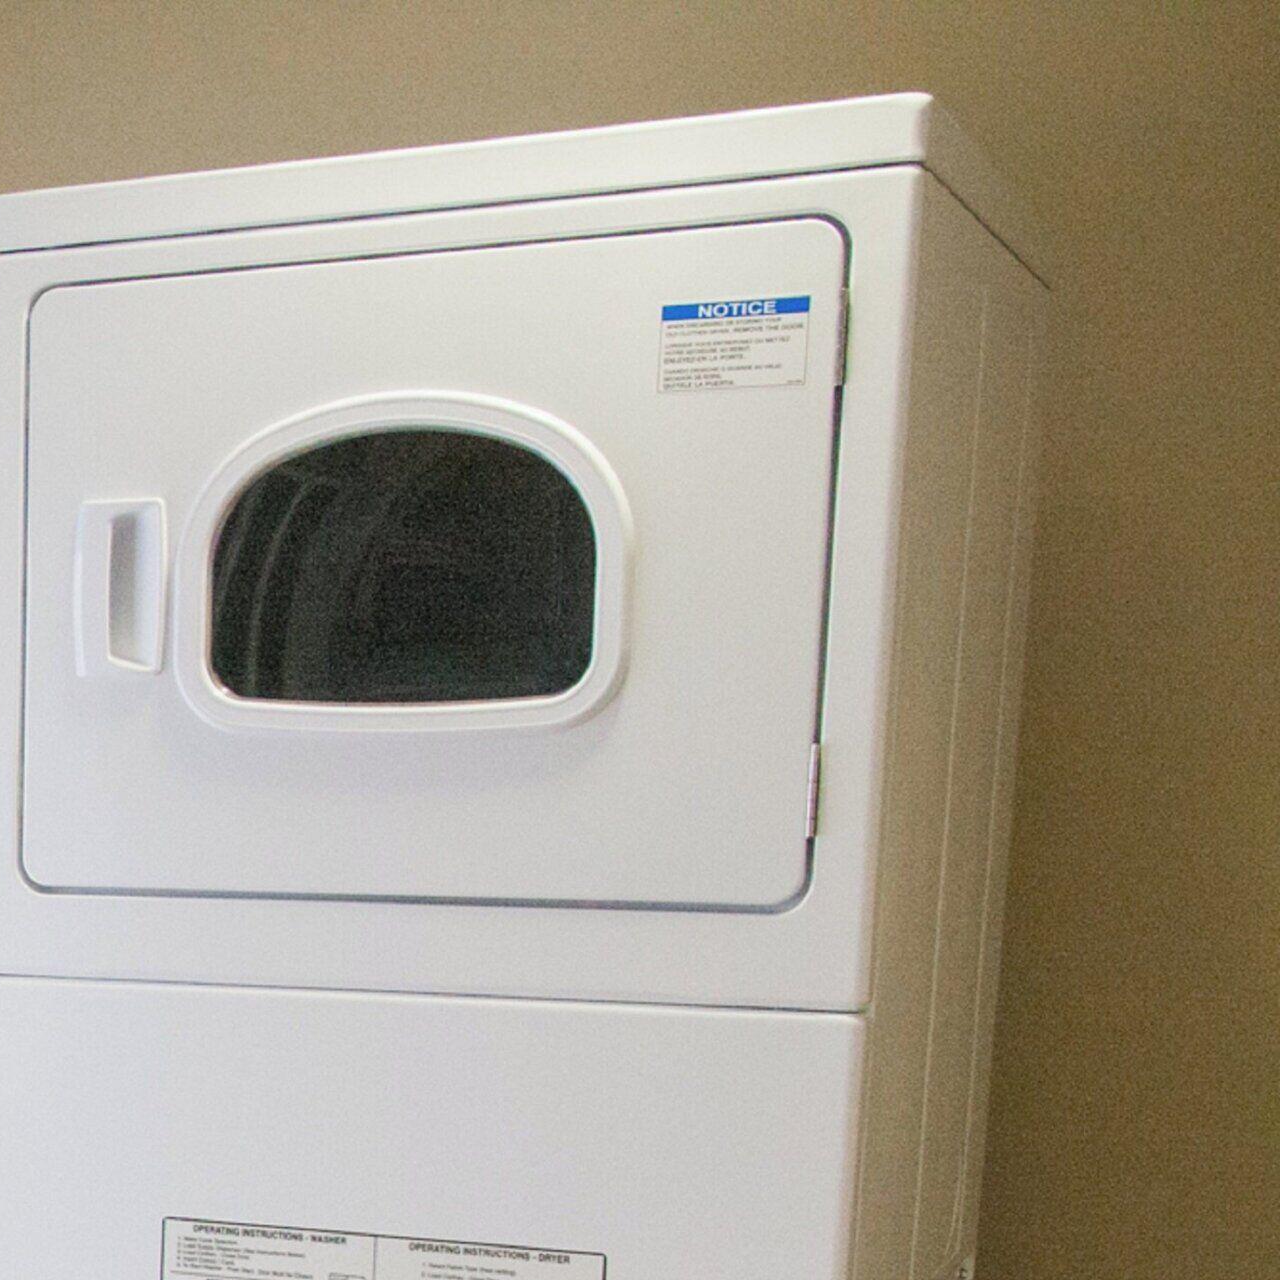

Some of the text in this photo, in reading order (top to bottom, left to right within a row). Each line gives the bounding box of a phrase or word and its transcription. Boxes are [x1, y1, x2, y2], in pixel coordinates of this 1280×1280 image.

[697, 300, 777, 318] NOTICE
[193, 1225, 240, 1236] OPERATING
[242, 1228, 304, 1242] INSTRUCTIONS
[311, 1236, 347, 1244] WASHER
[409, 1242, 460, 1255] OPERATING
[462, 1246, 530, 1262] INSTRUCTIONS
[538, 1253, 570, 1264] DRYER
